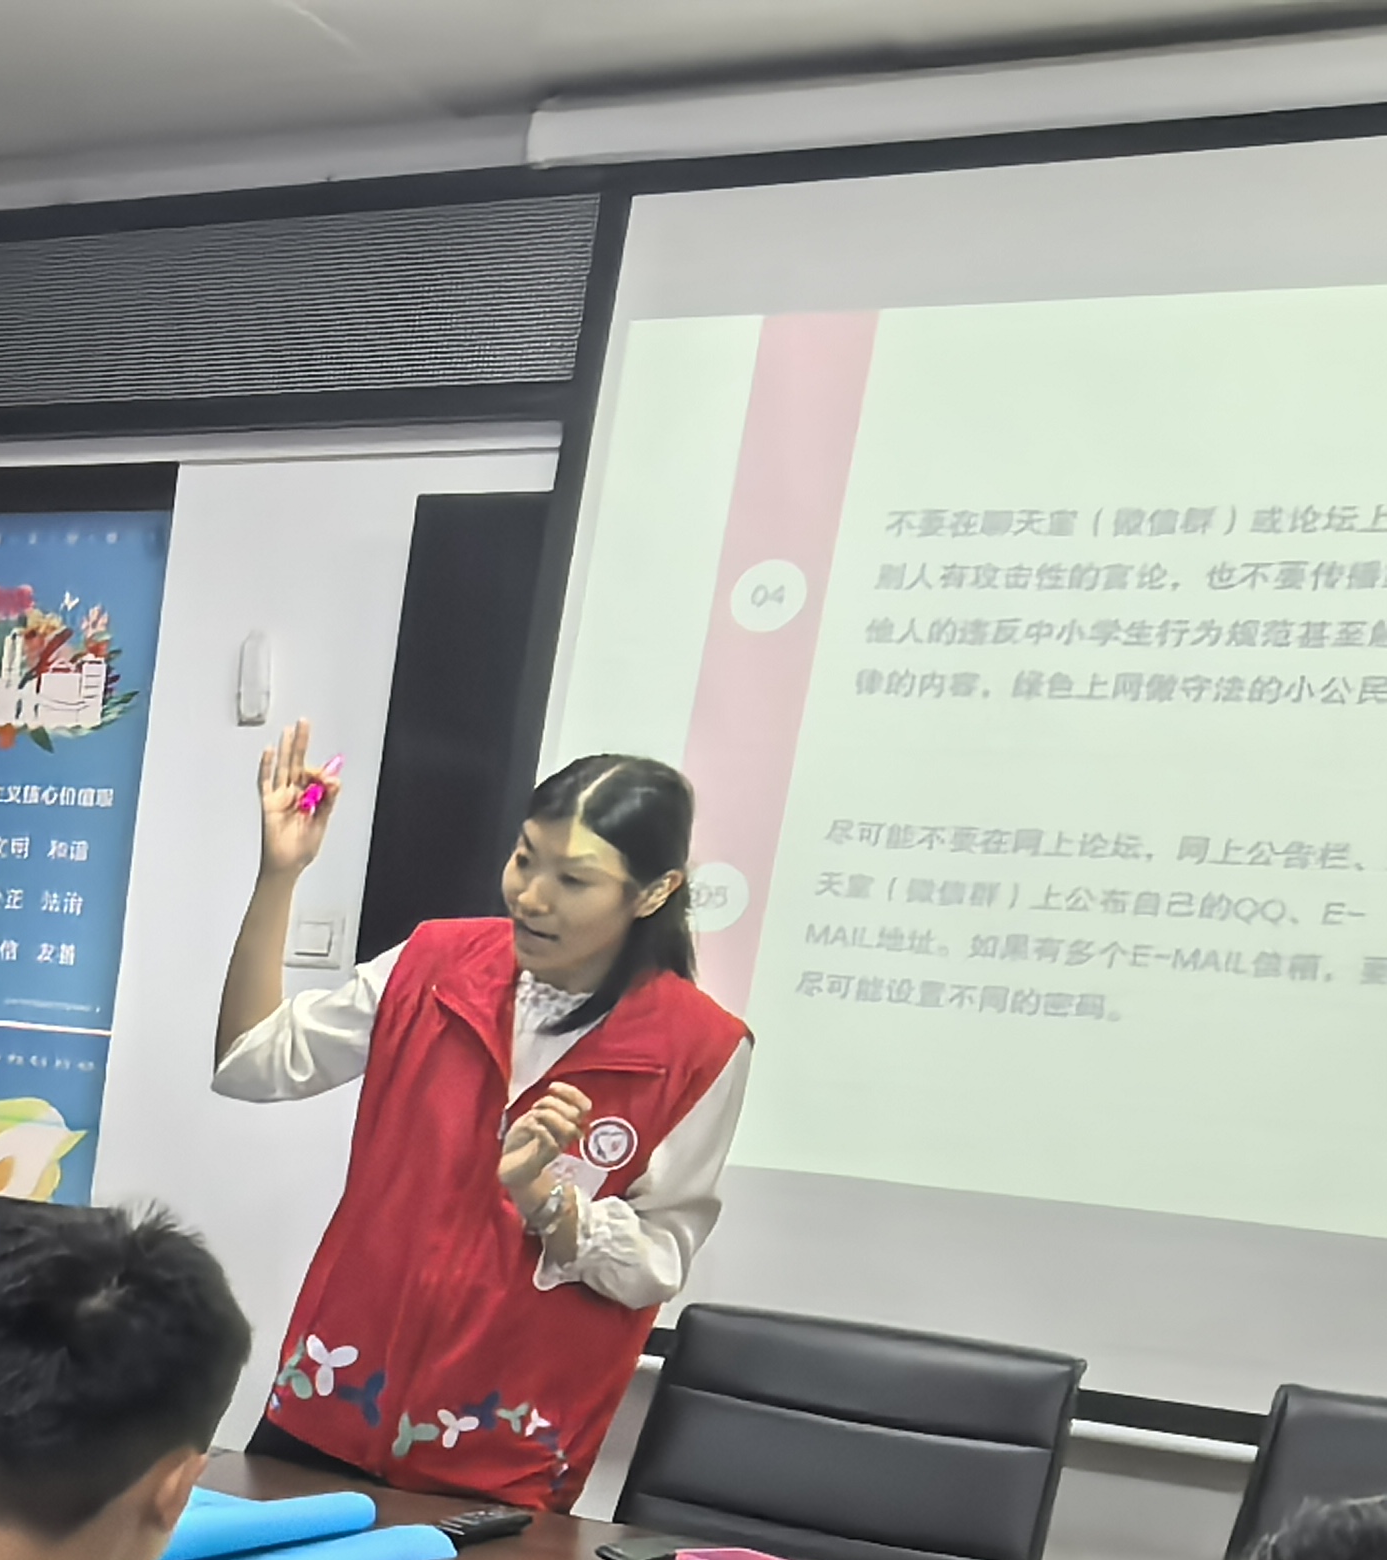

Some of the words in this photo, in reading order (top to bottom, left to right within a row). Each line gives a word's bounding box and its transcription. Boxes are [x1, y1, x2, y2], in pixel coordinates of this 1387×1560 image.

[875, 561, 1387, 591] 别人有攻击性的言论，也不要传播
[750, 584, 786, 609] 04
[47, 840, 89, 862] 和谐
[41, 891, 84, 916] 法治
[36, 943, 76, 966] 友善
